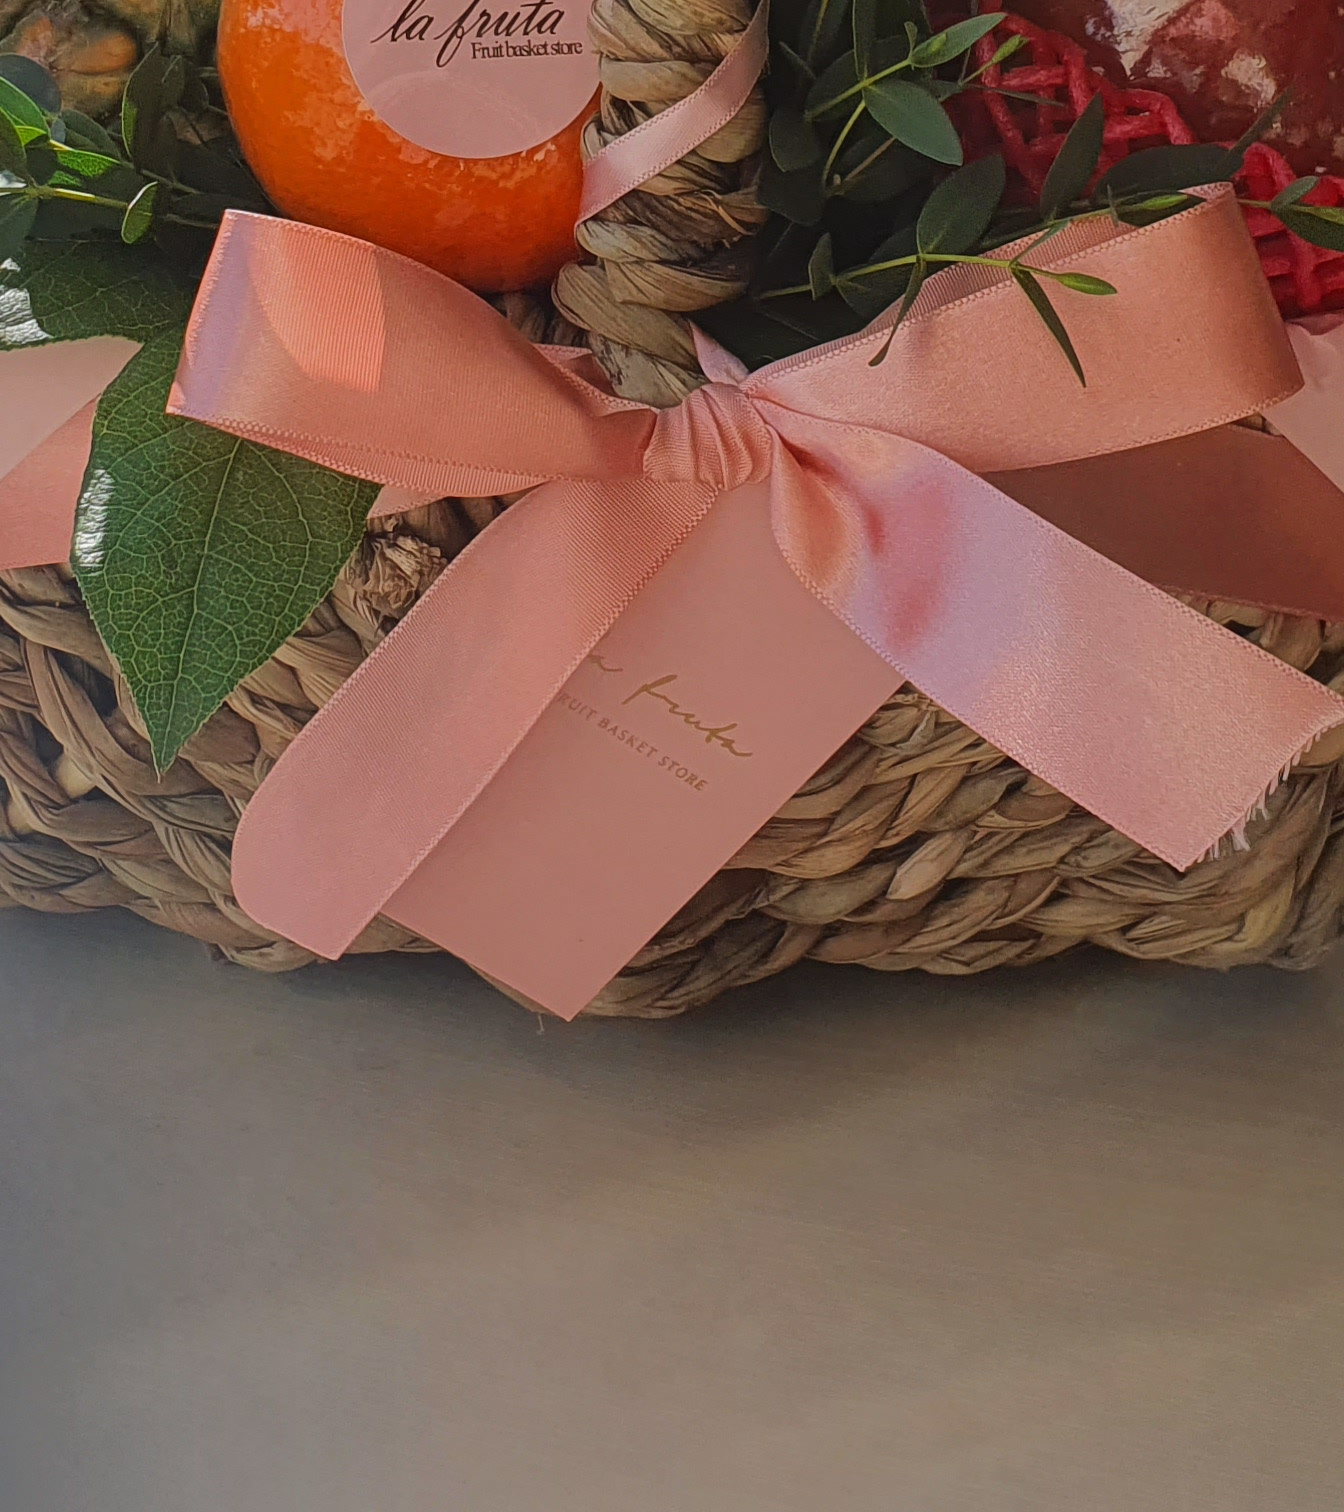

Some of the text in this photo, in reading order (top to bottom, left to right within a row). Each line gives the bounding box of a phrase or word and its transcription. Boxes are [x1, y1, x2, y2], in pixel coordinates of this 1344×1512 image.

[471, 39, 583, 59] Fruit basket store
[556, 691, 709, 792] RUIT BASKET STORE
